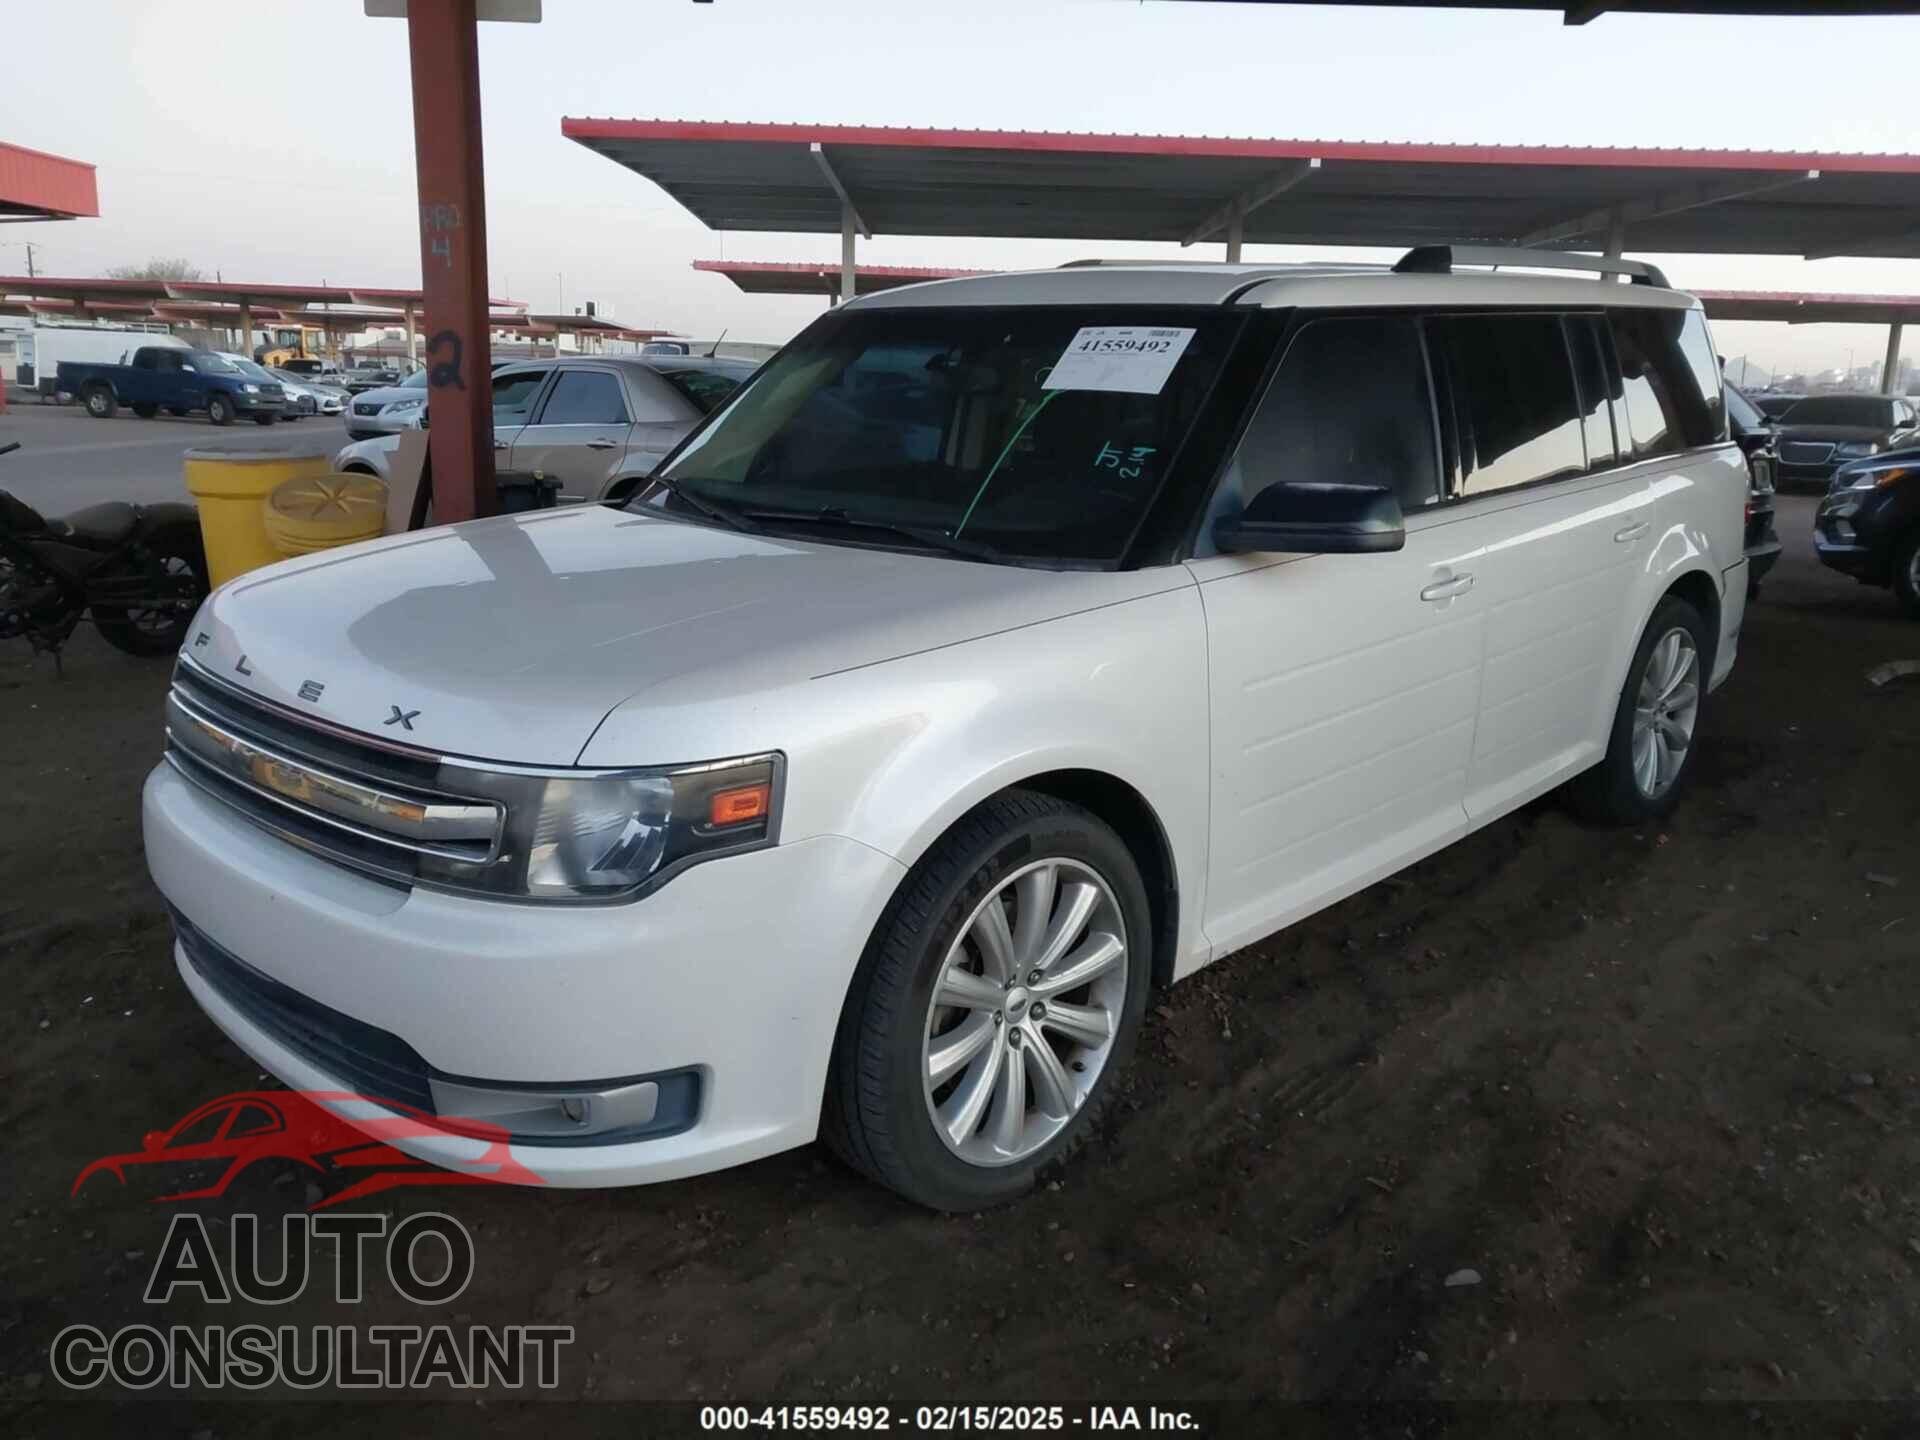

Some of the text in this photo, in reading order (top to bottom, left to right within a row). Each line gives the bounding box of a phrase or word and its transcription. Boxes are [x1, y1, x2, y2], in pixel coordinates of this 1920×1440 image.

[431, 237, 453, 268] 4
[430, 329, 466, 391] 2
[1078, 339, 1171, 353] 41559492
[195, 632, 421, 731] FLEX
